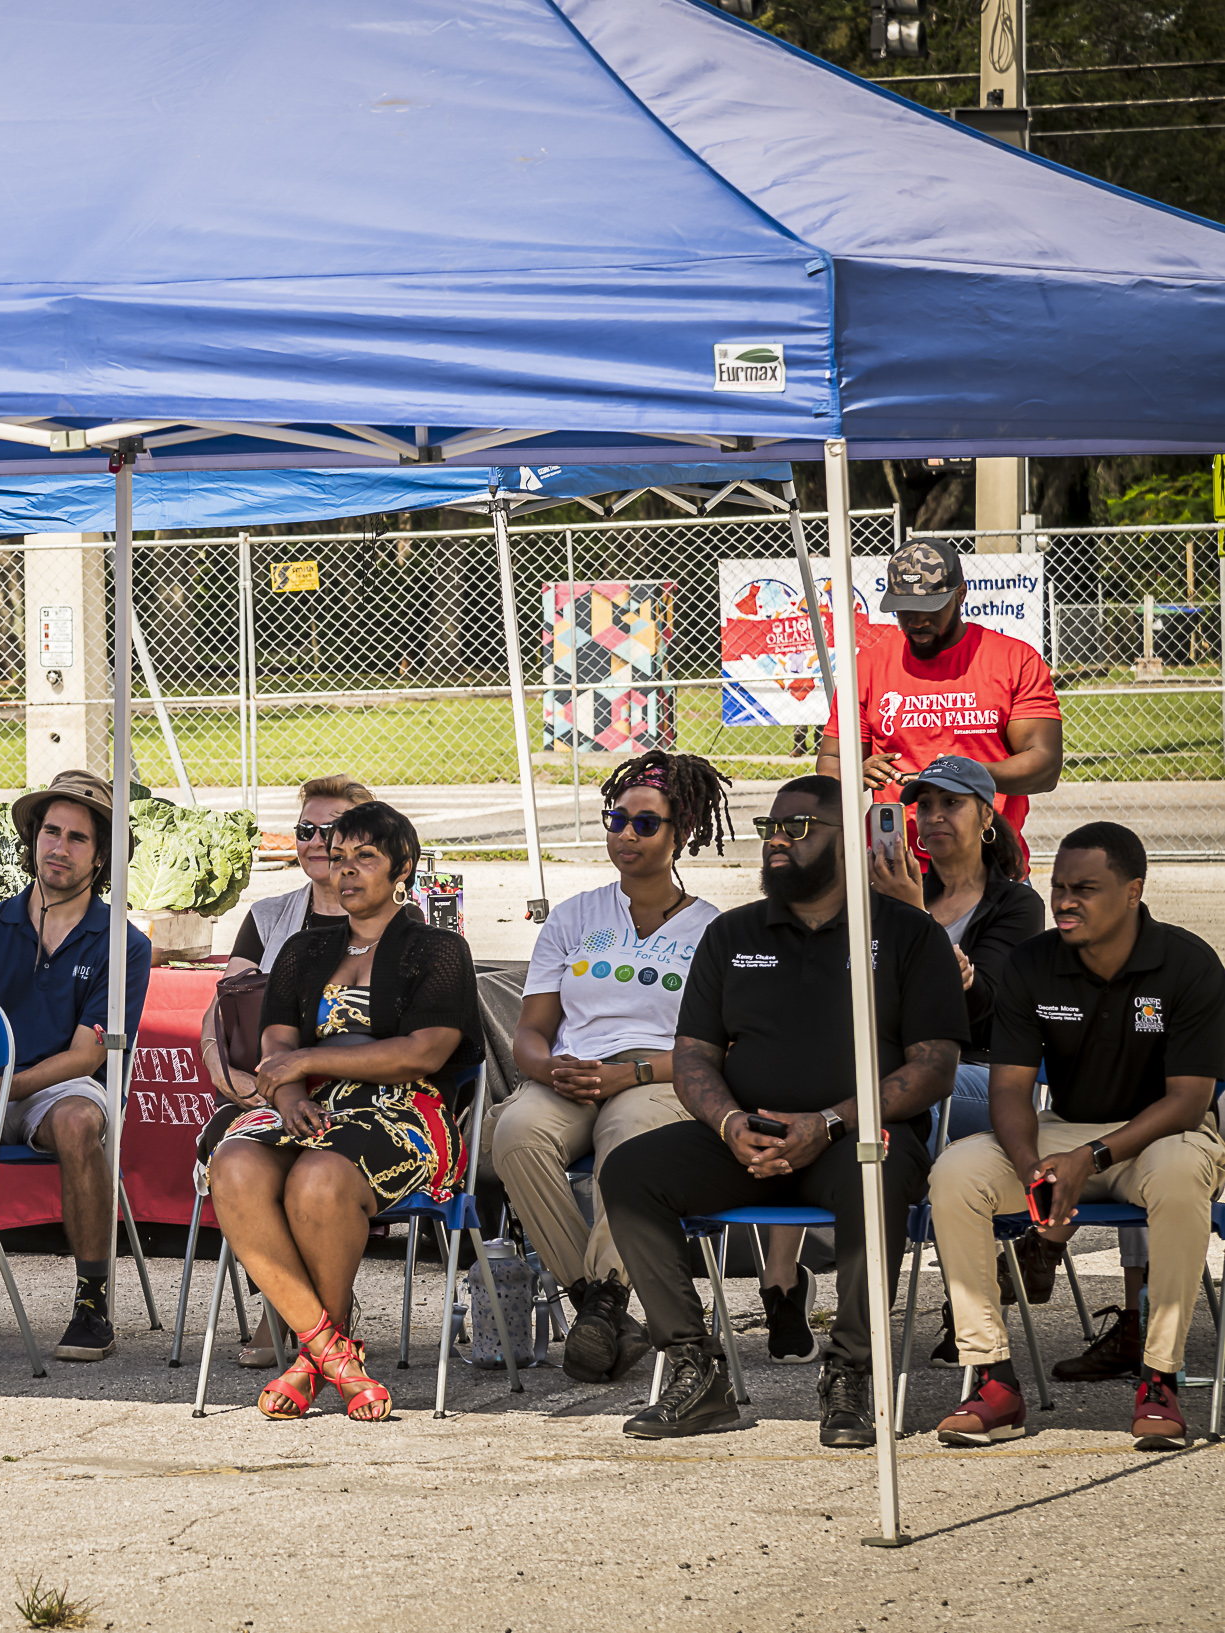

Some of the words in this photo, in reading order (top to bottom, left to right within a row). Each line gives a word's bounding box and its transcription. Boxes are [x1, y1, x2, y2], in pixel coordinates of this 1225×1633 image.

[719, 363, 777, 382] Eurmax
[903, 692, 977, 711] INFINITE
[901, 713, 941, 728] ZION
[944, 710, 999, 727] FARMS
[622, 928, 696, 960] IDEAS
[635, 951, 654, 960] For
[657, 955, 671, 964] Us
[1134, 997, 1162, 1009] ORANGE
[1135, 1012, 1163, 1024] COUNTY
